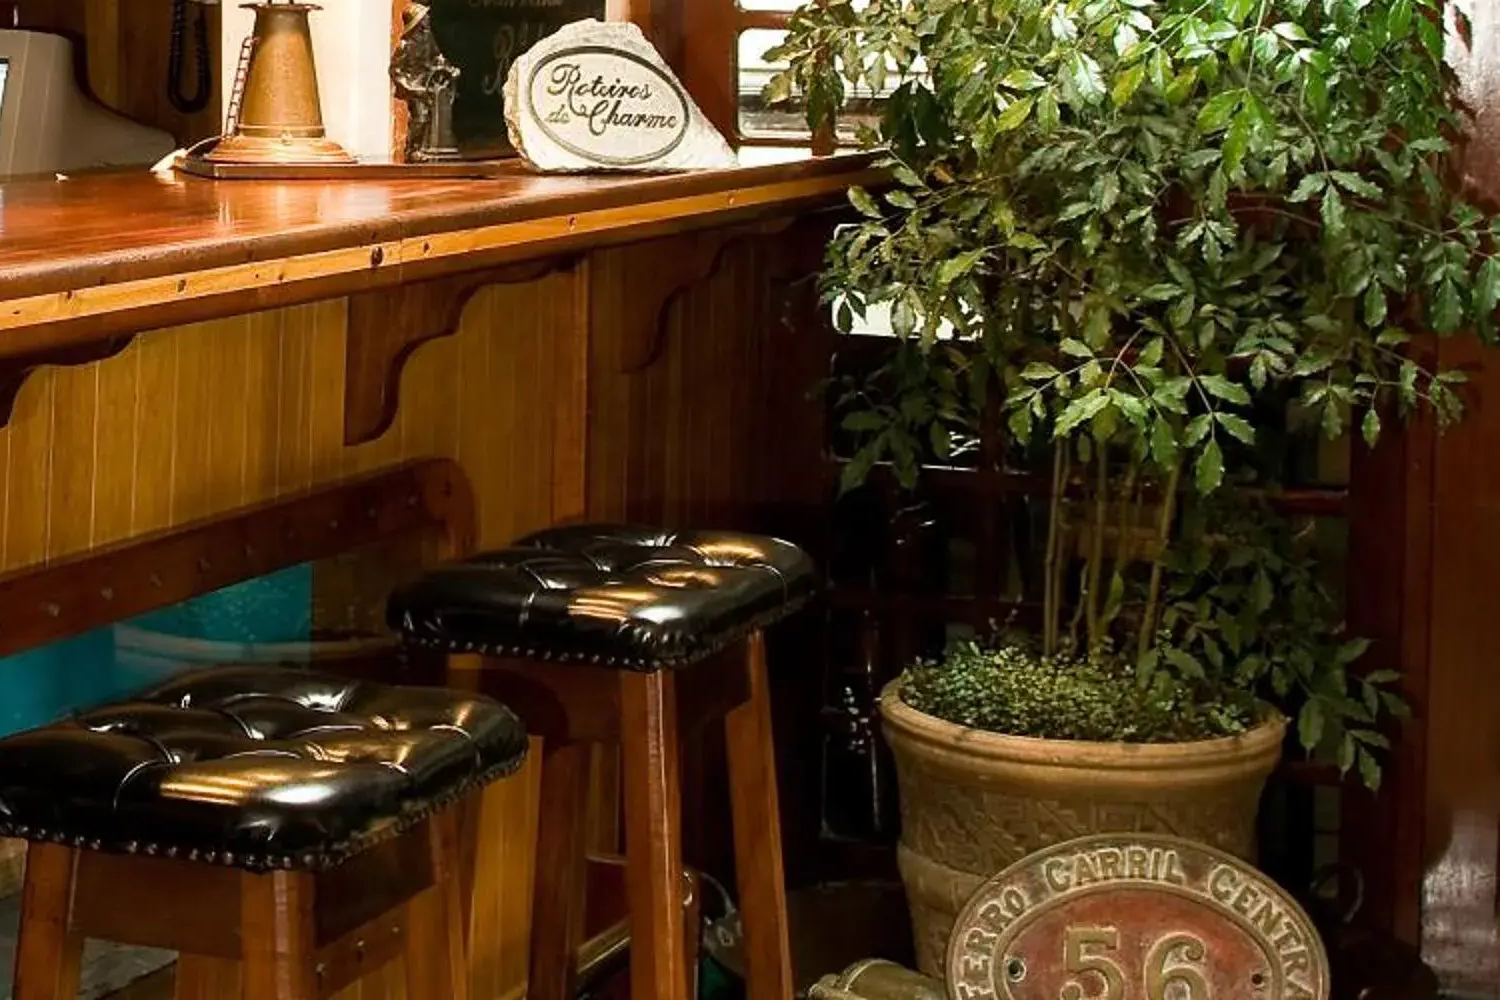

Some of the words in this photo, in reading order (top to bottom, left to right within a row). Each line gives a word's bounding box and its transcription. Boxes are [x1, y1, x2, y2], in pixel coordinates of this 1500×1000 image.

[547, 63, 651, 116] Roteiros
[588, 99, 677, 136] Charme
[956, 886, 1026, 1000] FERRO
[1043, 845, 1185, 892] CARRIL
[1060, 924, 1212, 1000] 56
